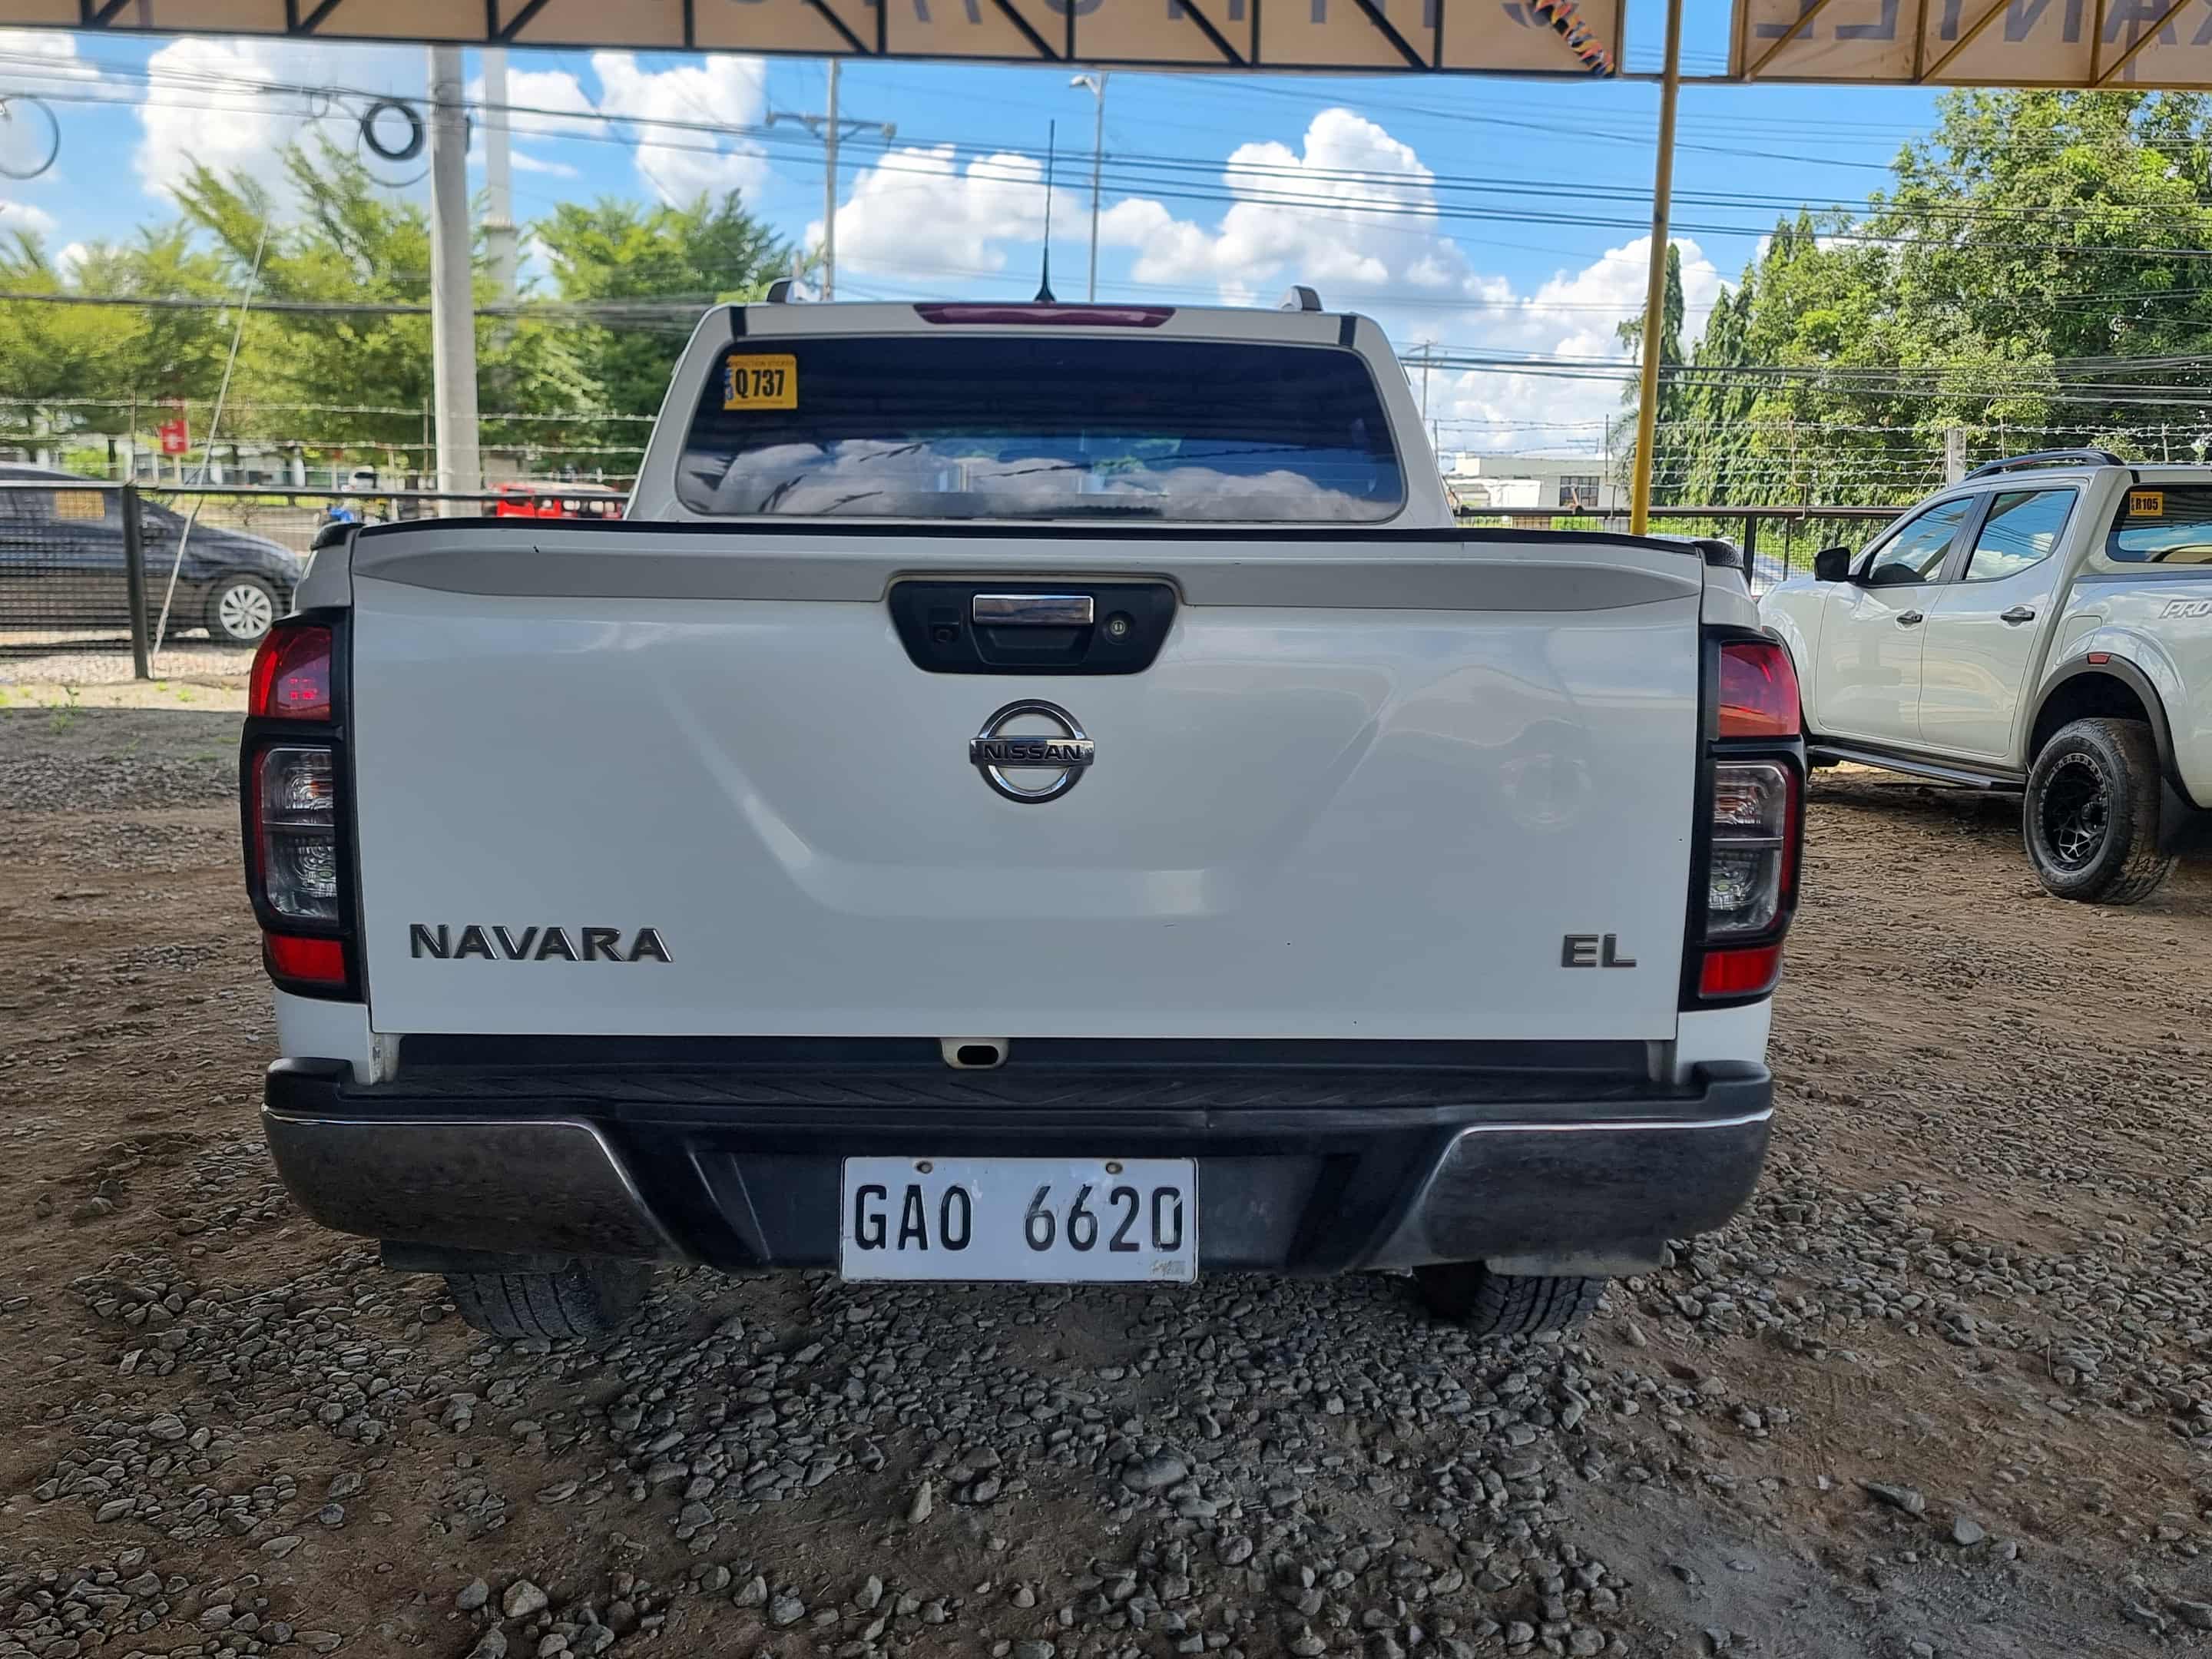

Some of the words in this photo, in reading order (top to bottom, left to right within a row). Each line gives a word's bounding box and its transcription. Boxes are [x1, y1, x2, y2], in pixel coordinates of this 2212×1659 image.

[983, 743, 1081, 761] NISSAN
[409, 923, 673, 962] NAVARA
[1561, 934, 1637, 968] EL
[854, 1184, 972, 1251] GAO
[1025, 1184, 1184, 1253] 6620
